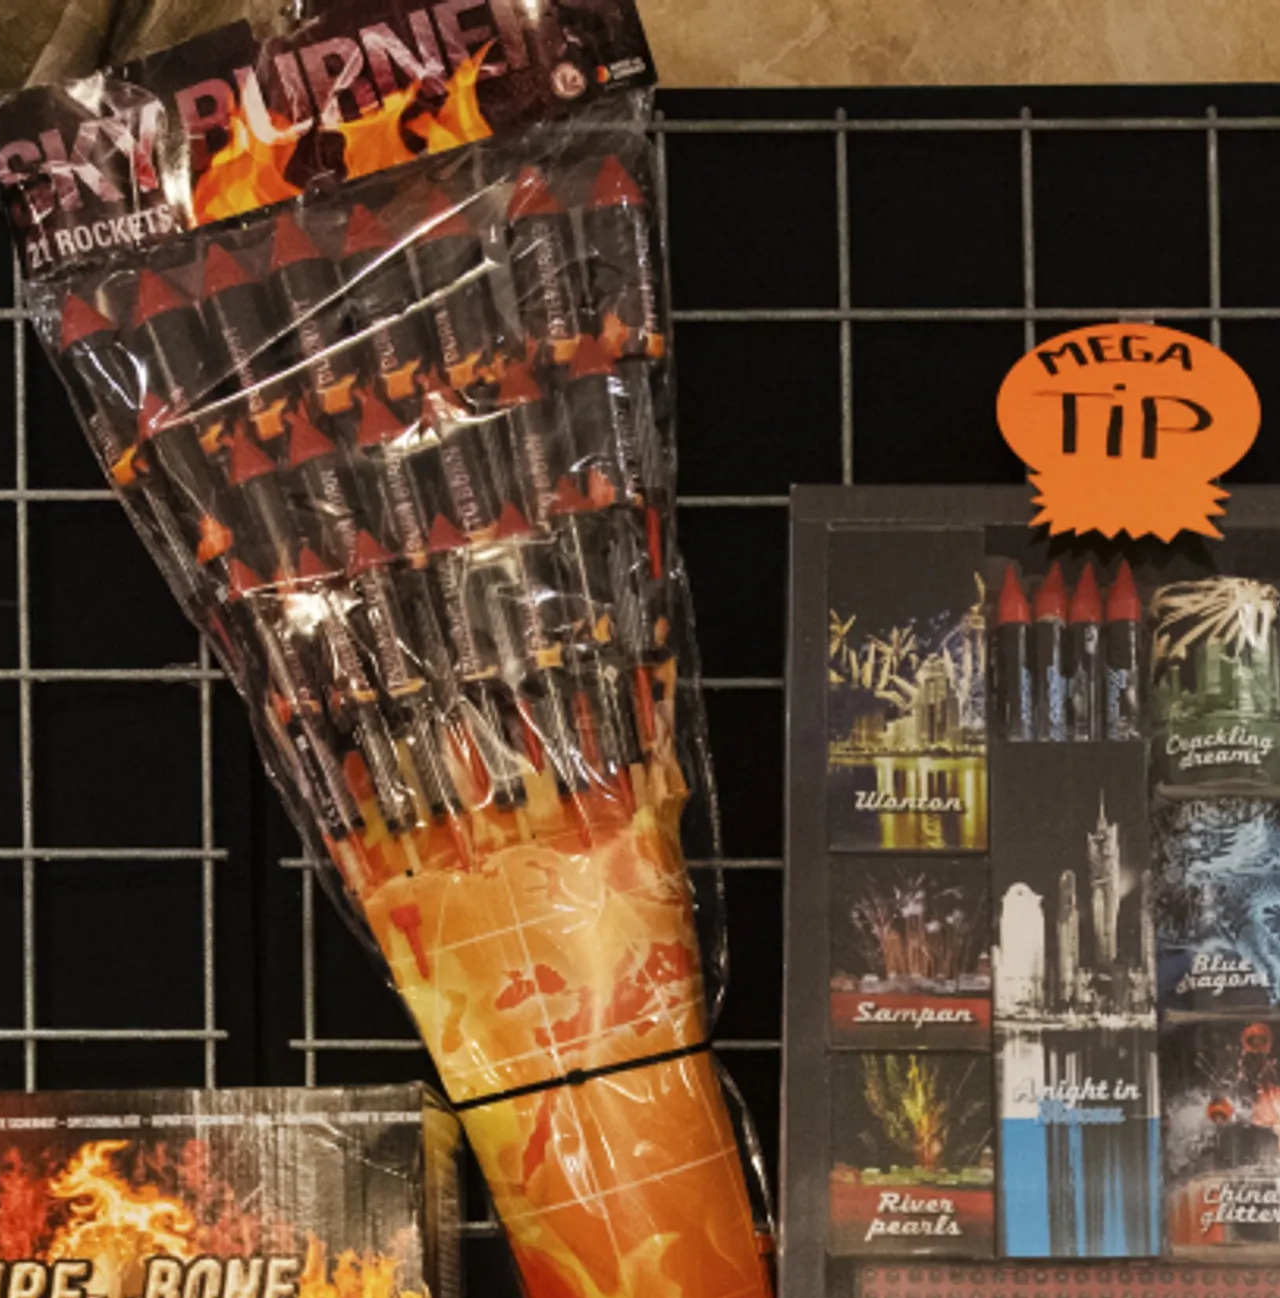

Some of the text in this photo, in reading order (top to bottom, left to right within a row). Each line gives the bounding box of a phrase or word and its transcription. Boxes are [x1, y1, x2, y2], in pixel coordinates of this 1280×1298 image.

[28, 205, 173, 268] 21 ROCKETS
[1036, 335, 1193, 375] MEGA
[1166, 725, 1274, 756] Crackling
[1177, 743, 1262, 769] dreams
[855, 791, 961, 812] Wonton
[1191, 954, 1251, 973] Blue
[1176, 968, 1273, 995] dragons
[854, 1003, 973, 1027] Sampan
[1037, 1077, 1109, 1109] night
[1114, 1079, 1141, 1100] in
[877, 1193, 954, 1215] River
[1204, 1181, 1280, 1205] China
[865, 1215, 961, 1242] pearls
